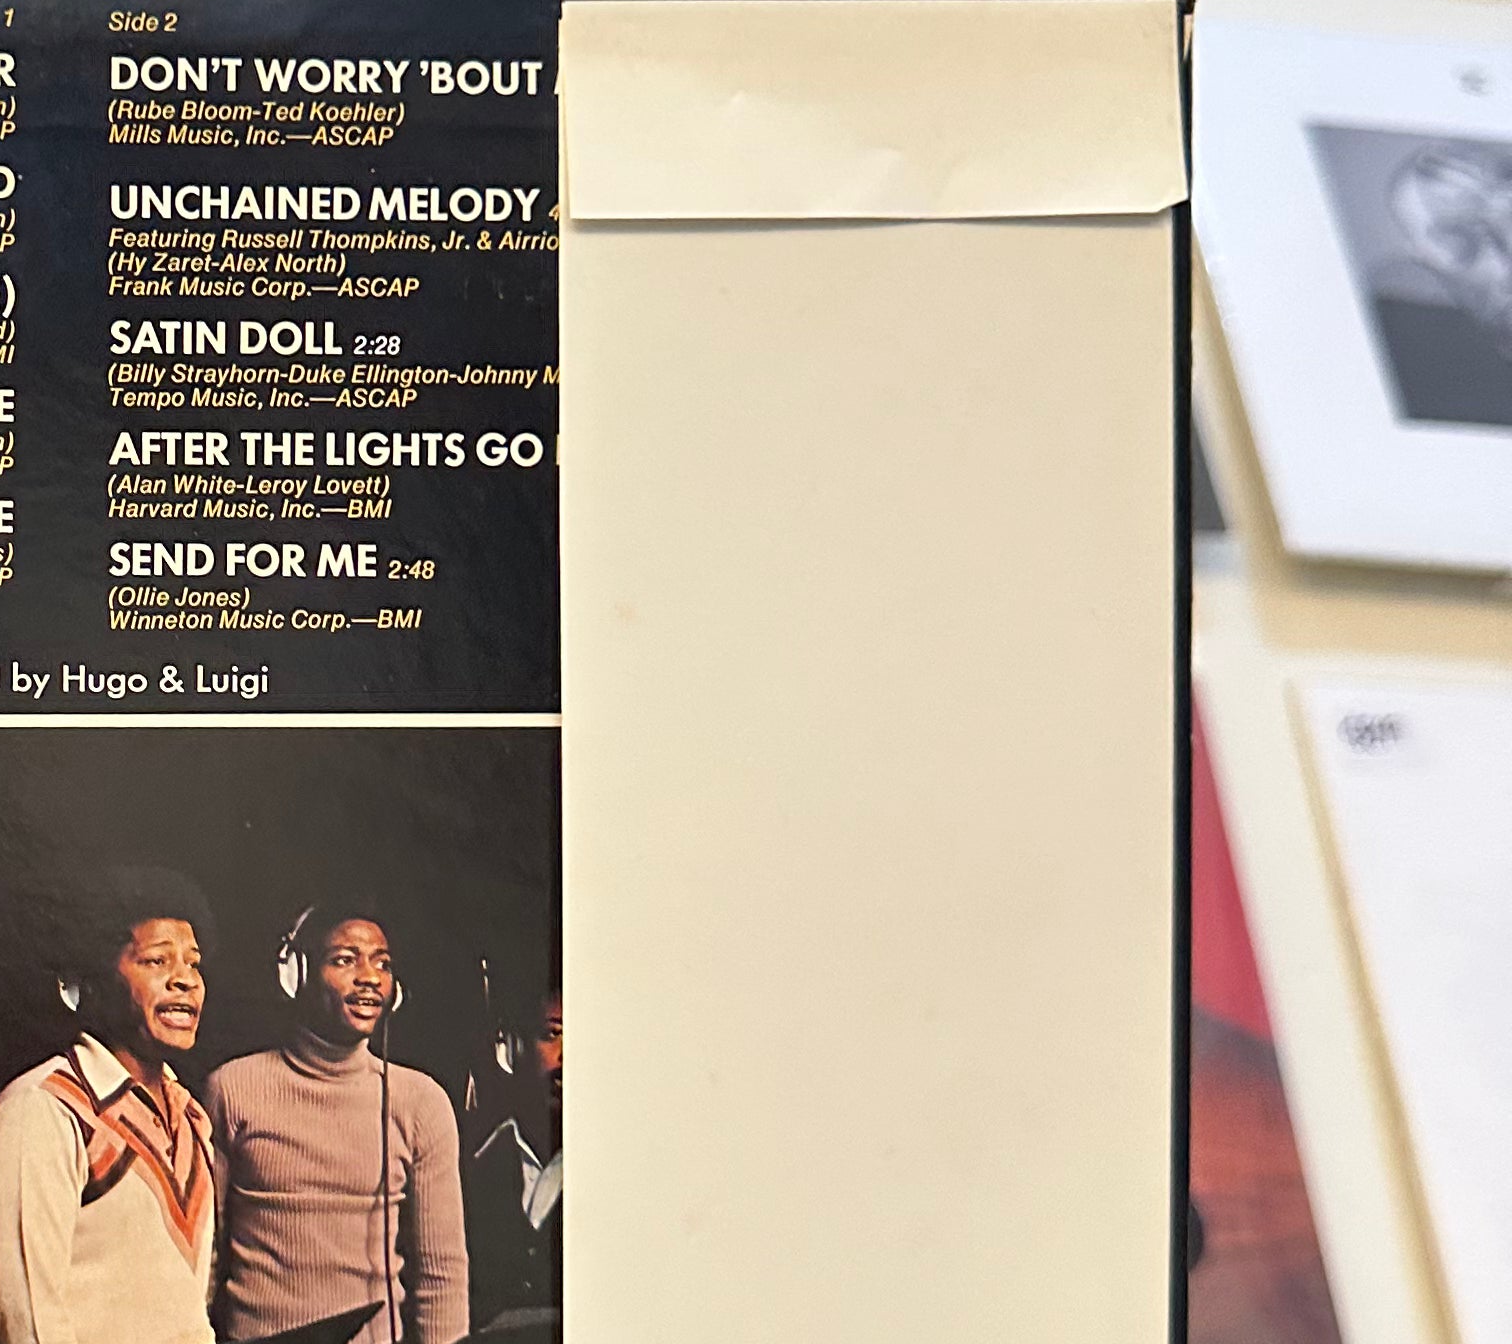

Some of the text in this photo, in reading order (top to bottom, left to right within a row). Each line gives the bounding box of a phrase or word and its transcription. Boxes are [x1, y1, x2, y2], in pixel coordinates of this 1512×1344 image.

[4, 8, 14, 28] 1
[108, 11, 178, 32] Side 2
[110, 56, 543, 96] DON'T WORRY 'BOUT
[108, 99, 405, 127] (Rube Bloom-Ted Koehler)
[110, 184, 361, 221] UNCHAINED
[368, 187, 541, 222] MELODY
[108, 227, 559, 254] Featuring Russell Thompkins, Jr. & Airrio
[109, 319, 401, 356] SATIN DOLL 2:28
[107, 362, 167, 388] (Billy
[170, 363, 346, 388] Strayhorn-Duke
[351, 364, 538, 389] Ellington-Johnny
[108, 431, 544, 468] AFTER THE LIGHTS GO
[108, 542, 436, 580] SEND FOR ME 2:48
[108, 585, 250, 610] (Ollie Jones)
[109, 609, 214, 630] Winneton
[218, 609, 286, 630] Music
[12, 661, 51, 700] by
[62, 664, 148, 699] Hugo
[159, 665, 185, 693] &
[196, 664, 269, 700] Luigi
